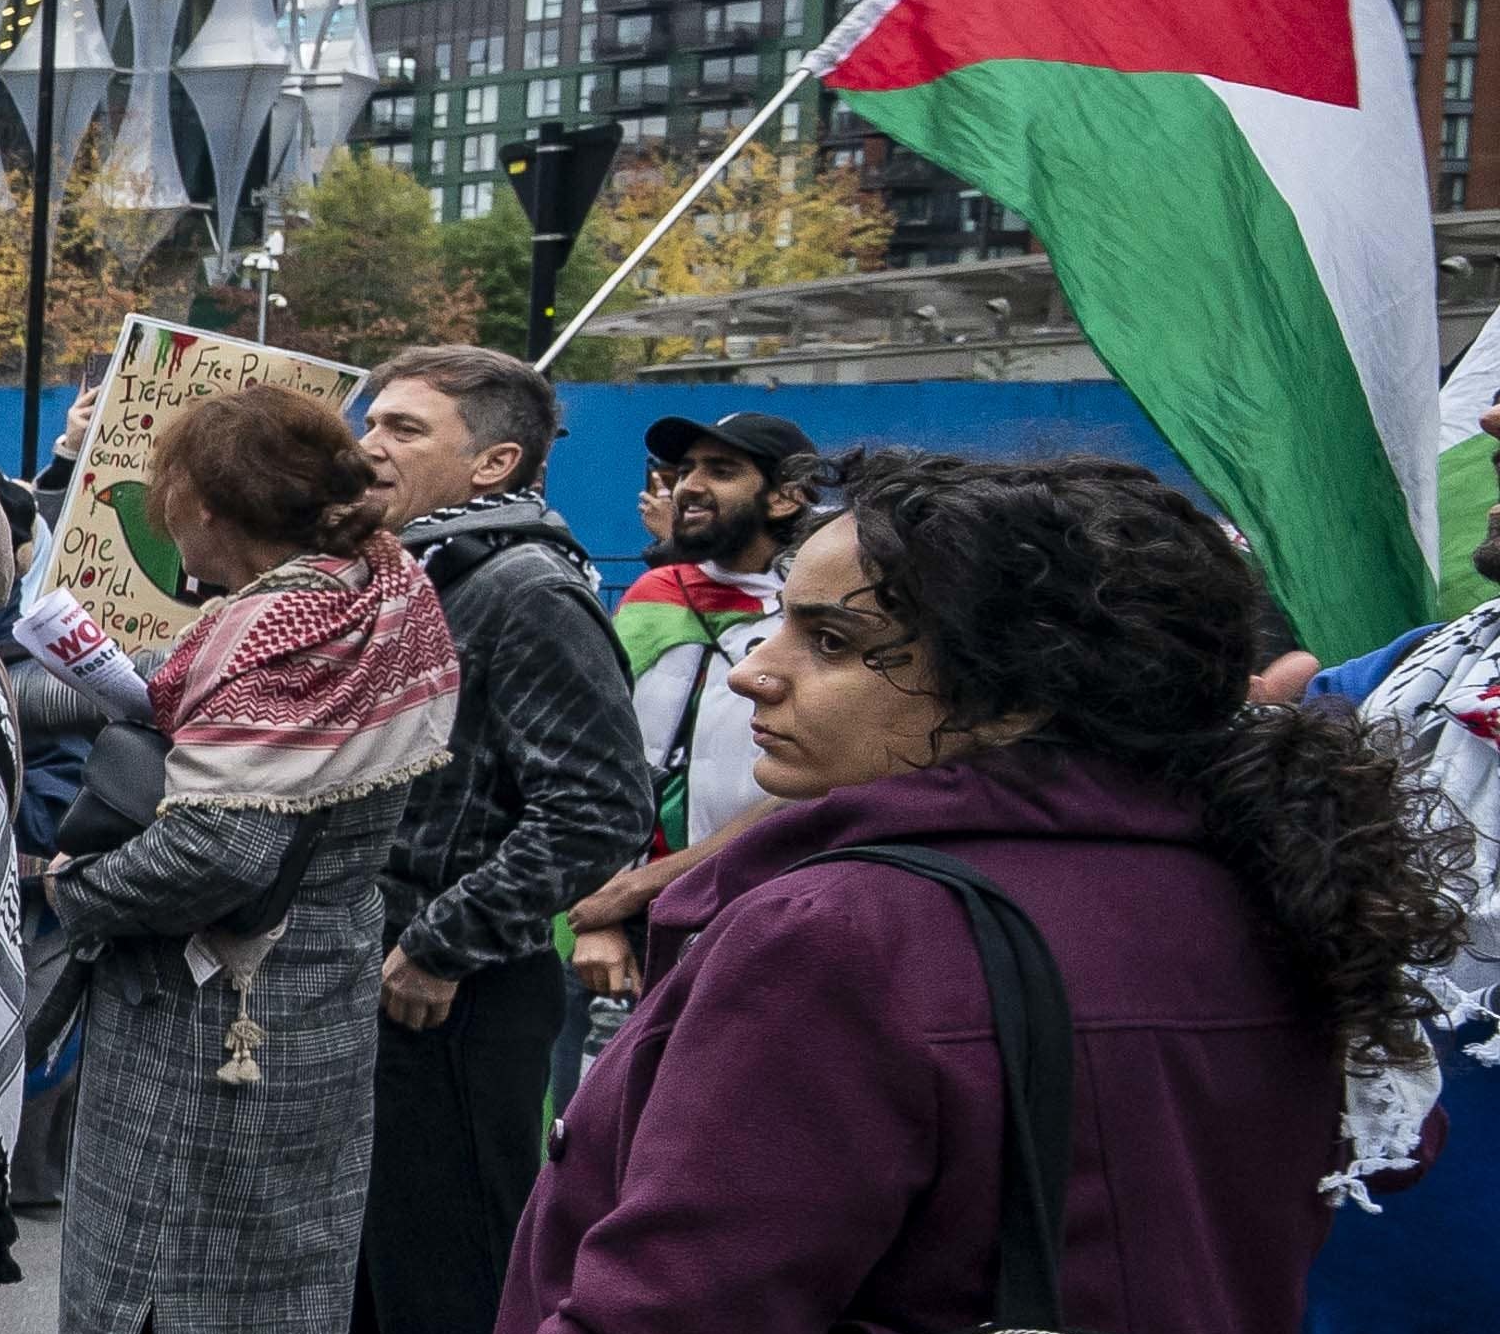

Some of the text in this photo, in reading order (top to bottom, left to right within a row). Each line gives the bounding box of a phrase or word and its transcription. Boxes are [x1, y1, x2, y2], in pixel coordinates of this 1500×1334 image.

[190, 346, 232, 380] Free
[117, 374, 212, 410] I refuse
[122, 405, 154, 431] to
[96, 423, 154, 450] Norm
[90, 449, 149, 469] Genoci
[63, 526, 115, 562] One
[71, 647, 118, 680] Restr
